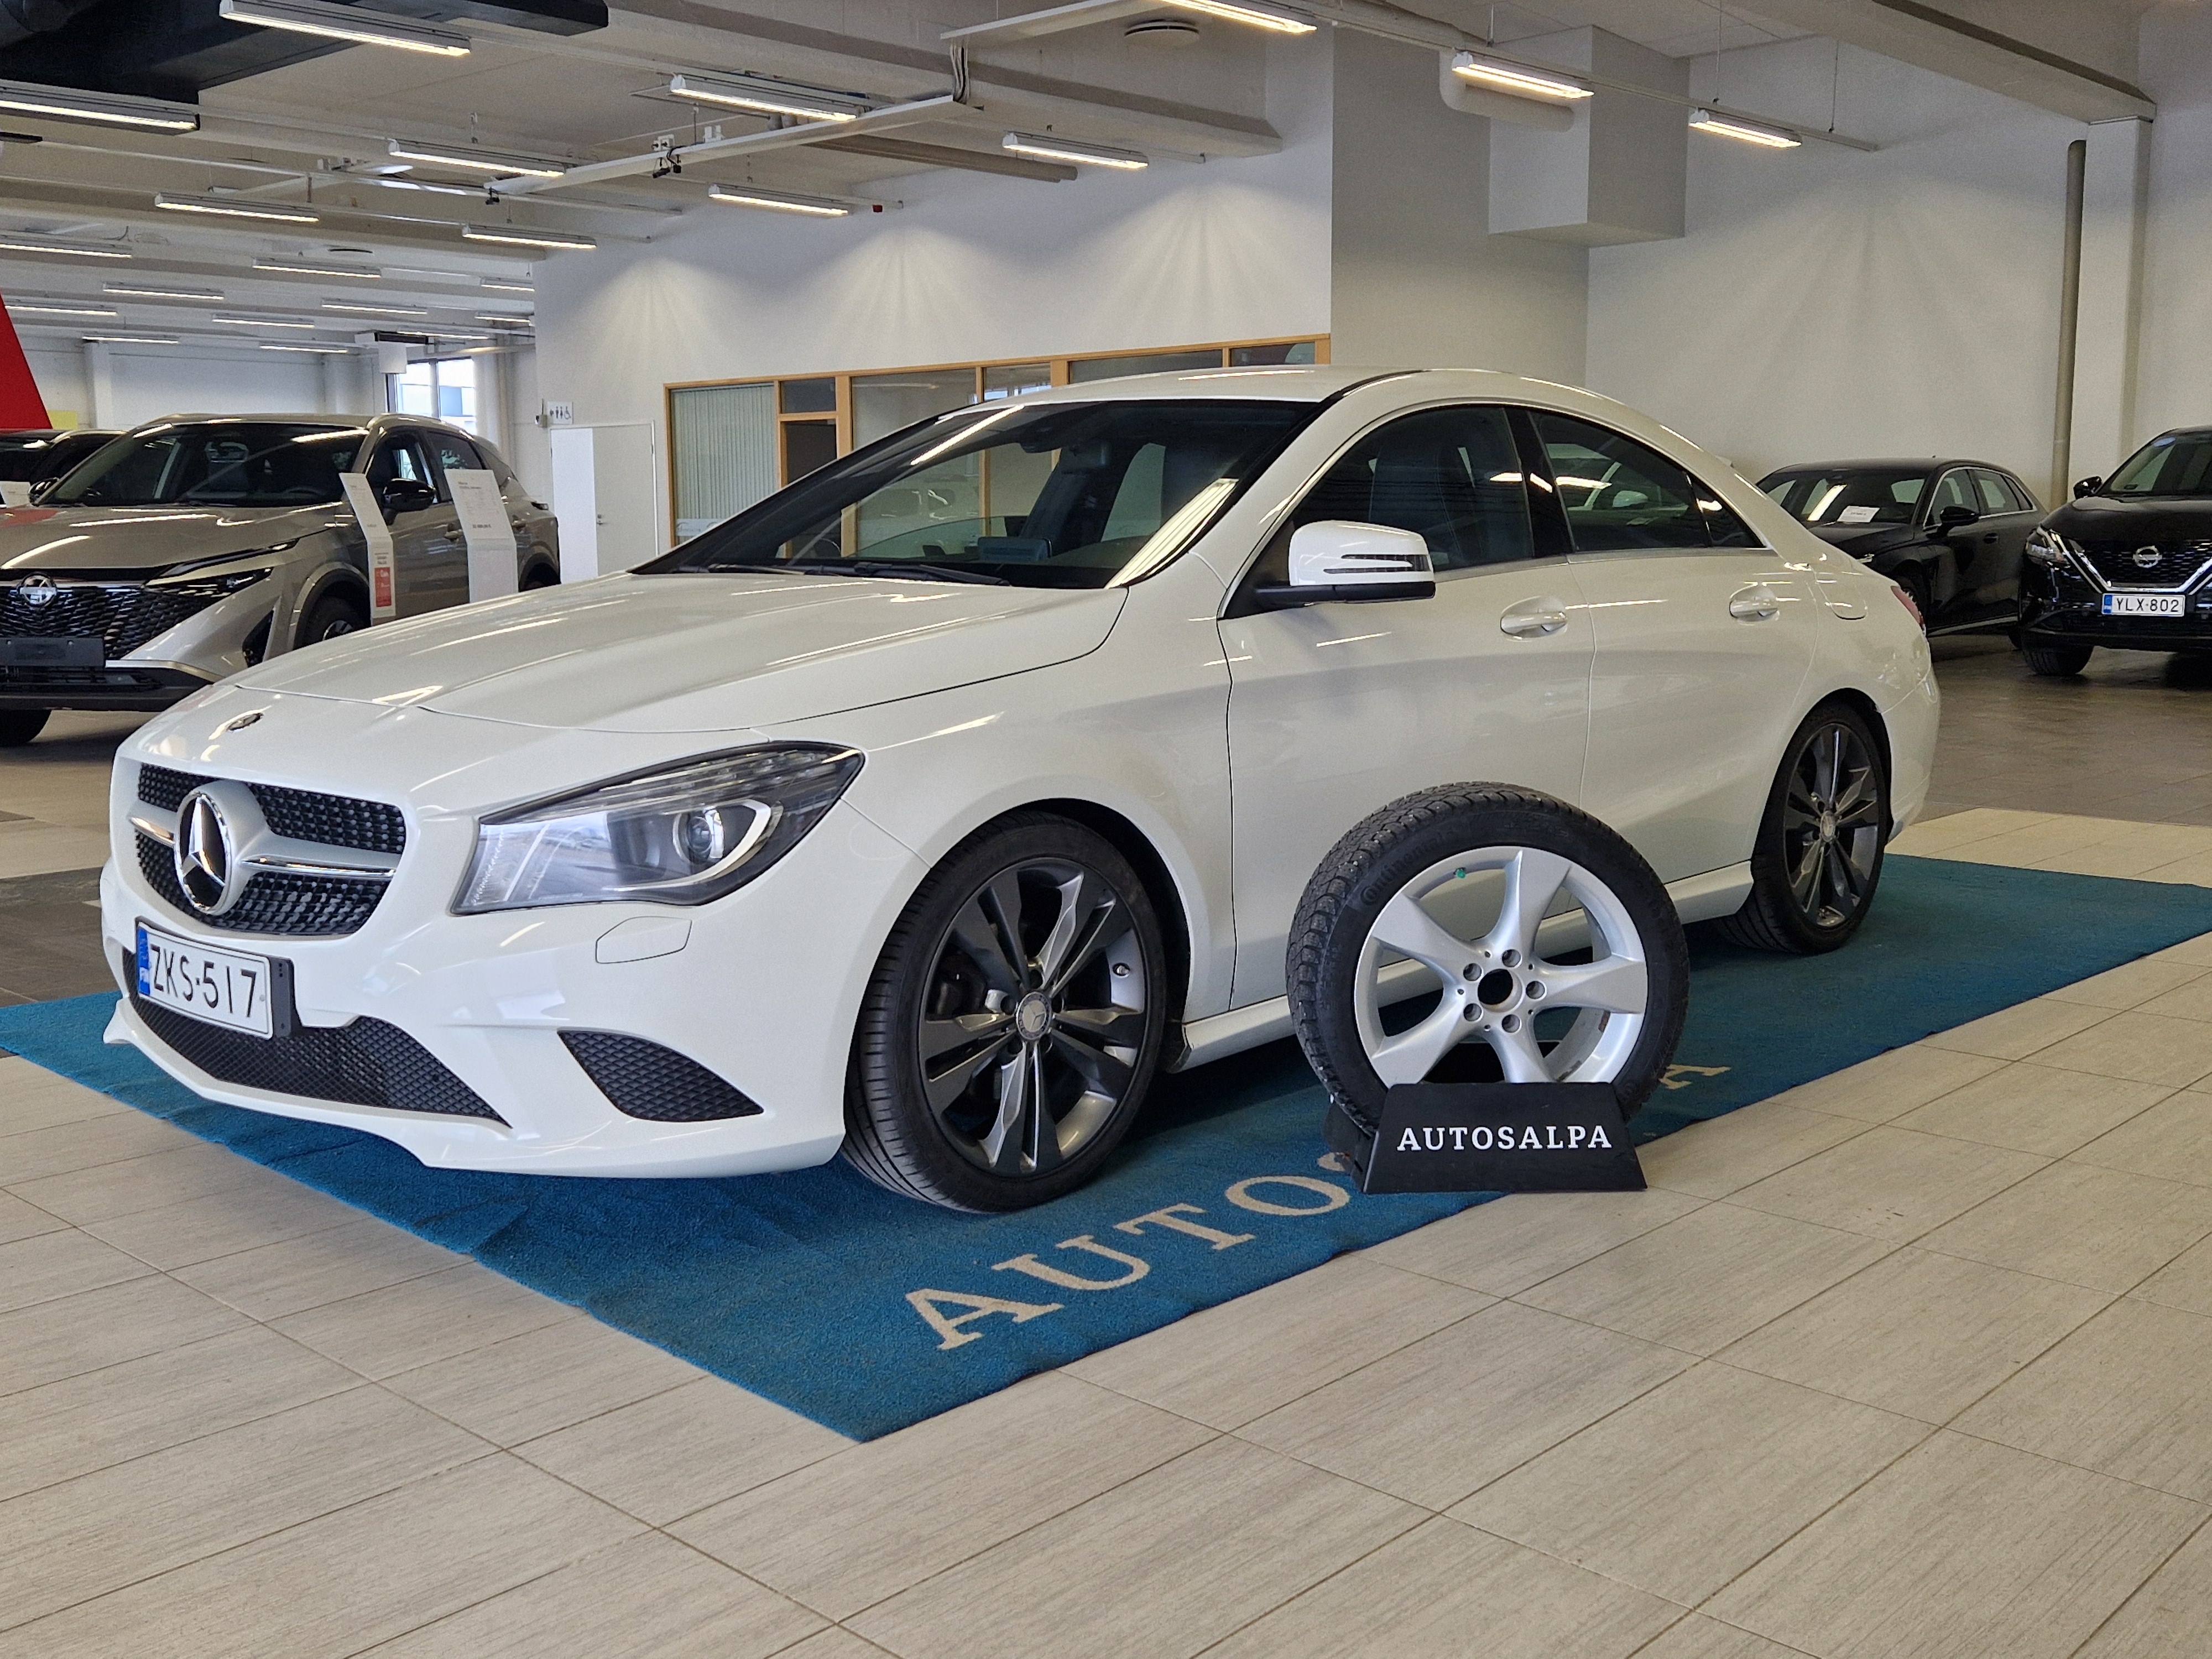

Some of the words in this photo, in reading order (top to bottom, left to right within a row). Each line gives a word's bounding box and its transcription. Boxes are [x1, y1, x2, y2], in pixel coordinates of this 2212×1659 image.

[2116, 597, 2179, 613] YLX-802
[150, 943, 257, 1018] ZKS-517
[1396, 1125, 1613, 1151] AUTOSALPA
